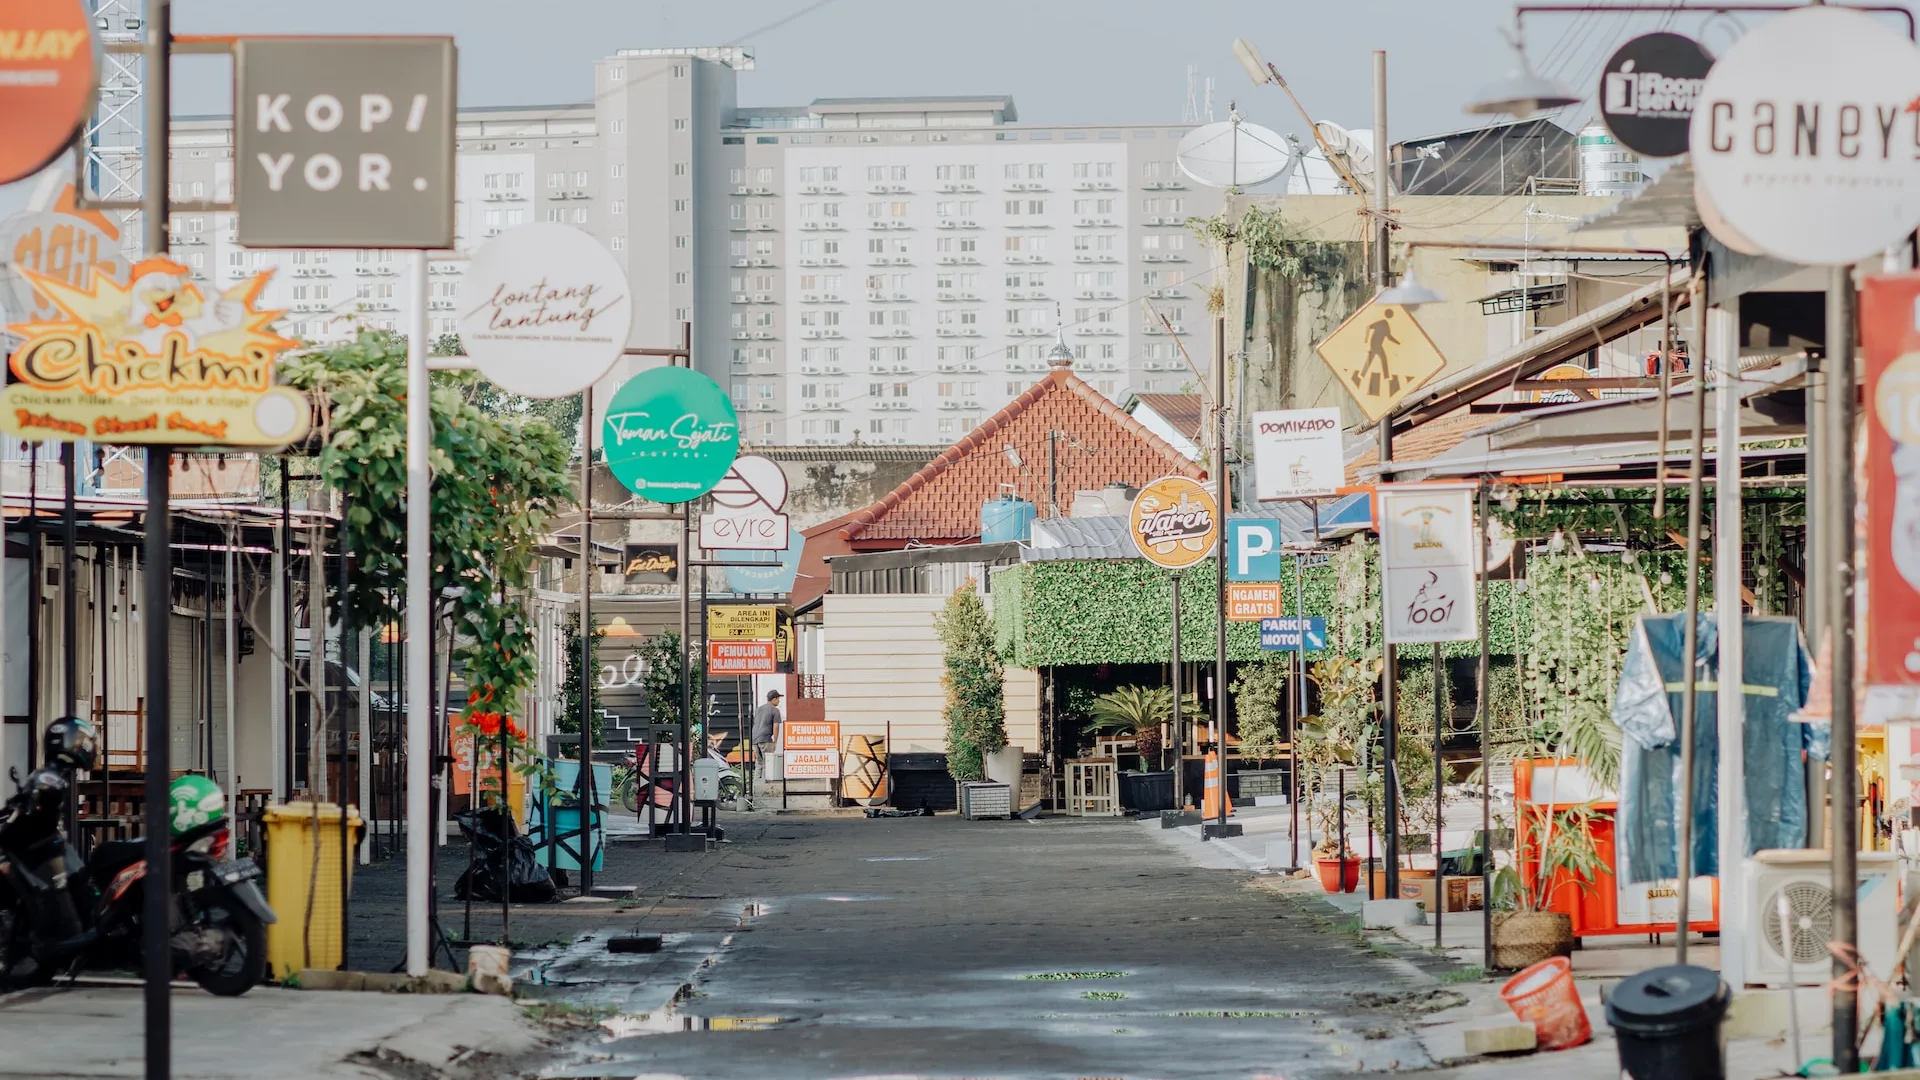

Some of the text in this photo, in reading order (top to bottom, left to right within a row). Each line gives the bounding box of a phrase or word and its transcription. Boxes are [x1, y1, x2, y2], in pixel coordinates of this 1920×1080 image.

[480, 276, 602, 309] lontang
[488, 299, 624, 332] lantung
[25, 332, 263, 384] Chickmi
[1260, 419, 1335, 435] DOMIKADO
[713, 518, 776, 543] eyre
[1237, 525, 1273, 575] P
[1233, 589, 1276, 600] NGAMEN
[1235, 603, 1274, 614] GRATIS
[1407, 600, 1455, 624] 1001
[1262, 619, 1312, 631] PARKR
[718, 645, 767, 657] PEMULUNG
[713, 658, 772, 669] DILARANG MASUK
[791, 725, 832, 735] PEMULUNG
[787, 735, 836, 745] DILARANG MASUK
[794, 755, 829, 763] JAGALAH
[787, 765, 836, 774] KEBERSIHAN
